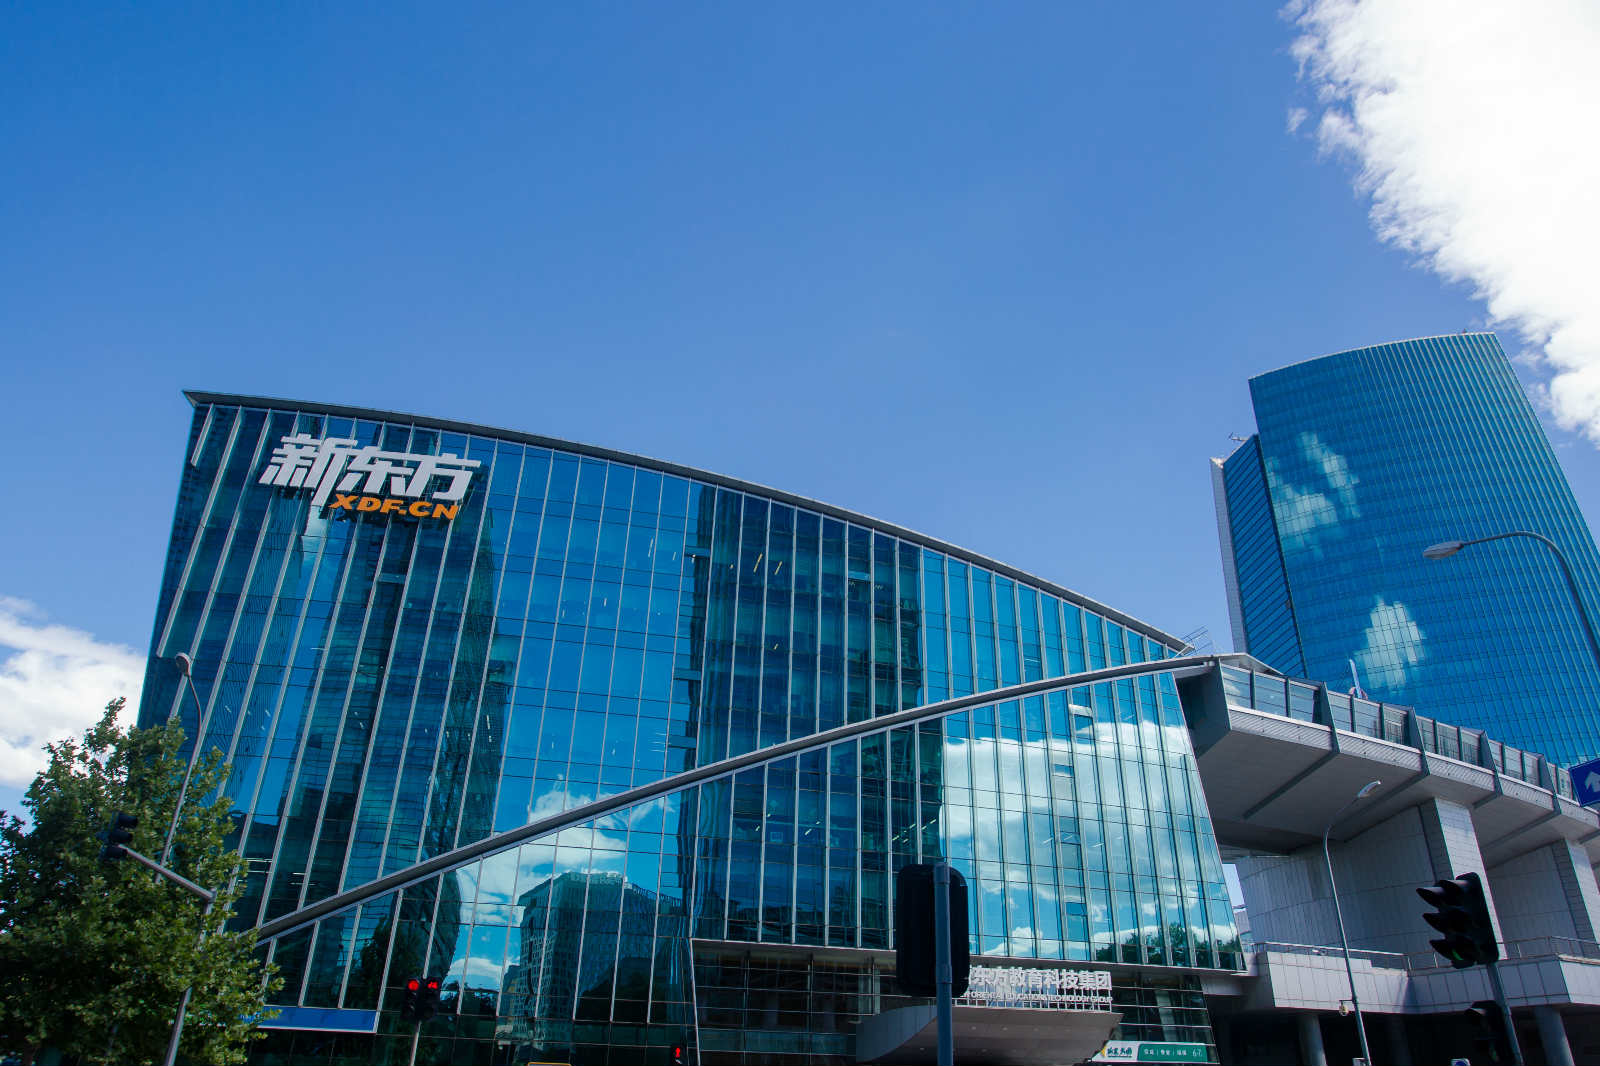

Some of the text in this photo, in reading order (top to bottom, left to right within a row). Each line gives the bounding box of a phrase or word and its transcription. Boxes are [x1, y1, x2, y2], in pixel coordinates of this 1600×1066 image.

[258, 433, 481, 506] 新东方
[328, 494, 461, 520] XDF.CN
[969, 965, 1113, 990] 东方教育科技集团
